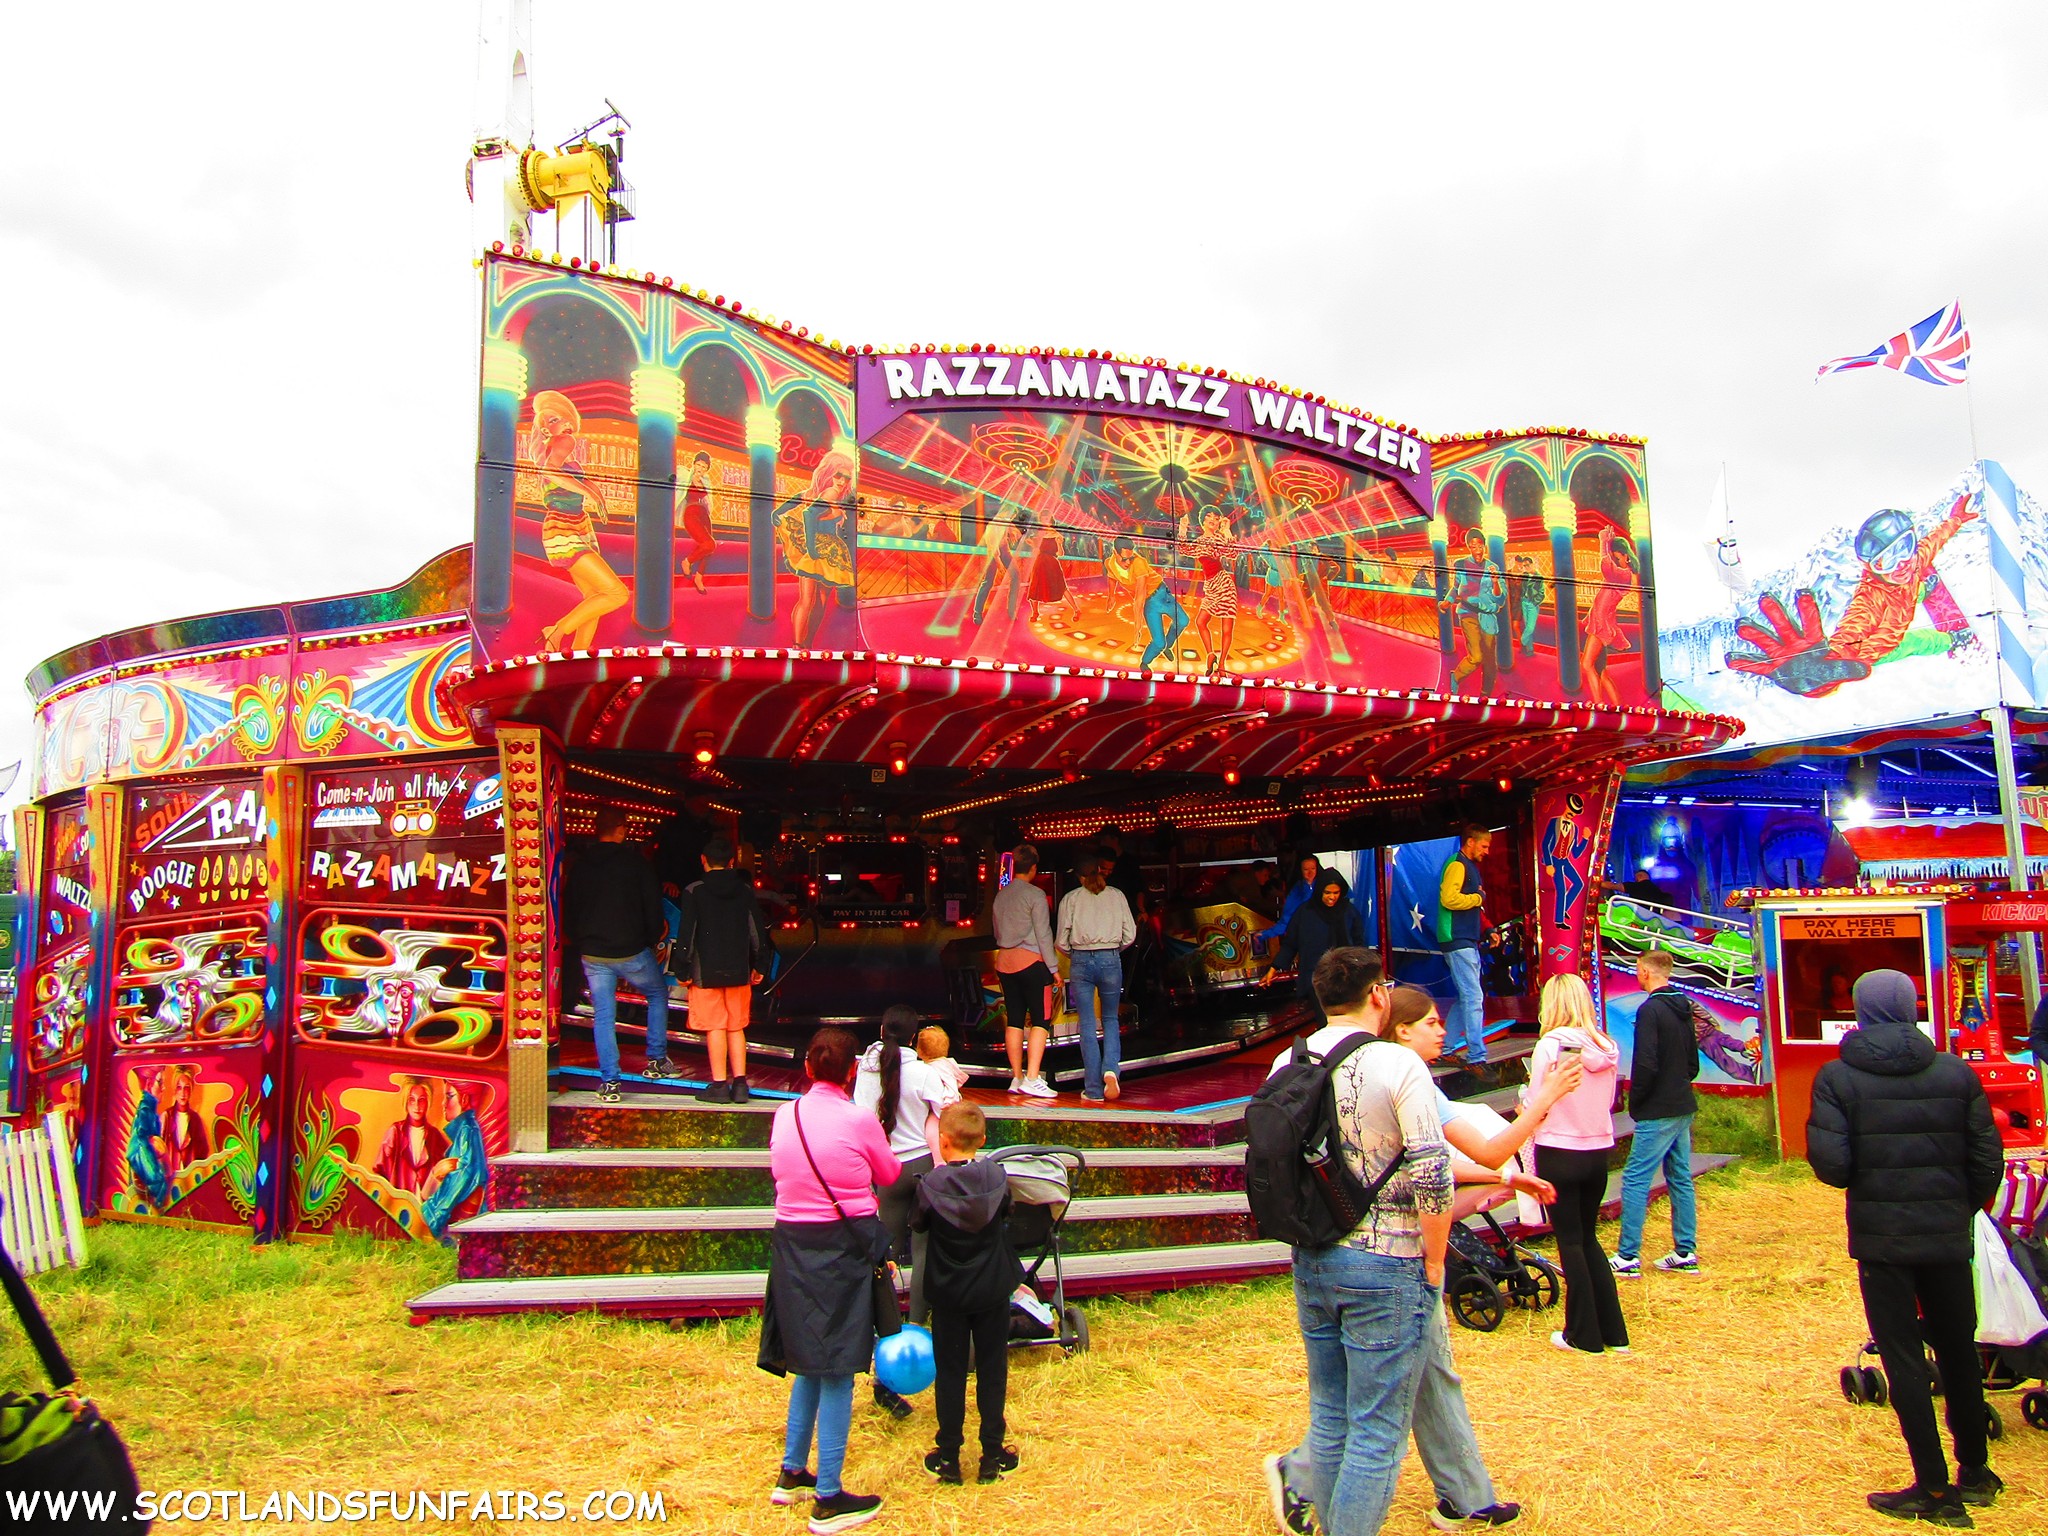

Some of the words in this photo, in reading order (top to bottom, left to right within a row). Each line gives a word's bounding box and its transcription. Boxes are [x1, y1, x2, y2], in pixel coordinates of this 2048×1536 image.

[884, 357, 1231, 419] RAZZAMATAZZ
[1246, 388, 1421, 475] WALTZER
[405, 774, 422, 798] all
[426, 772, 448, 798] the
[136, 790, 196, 849] SOUL
[312, 850, 506, 895] RAZZAMATAZZ
[130, 860, 196, 913] BOOGIE
[833, 909, 851, 917] PAY
[855, 909, 865, 917] IN
[868, 909, 887, 917] THE
[890, 909, 910, 917] CAR
[1803, 919, 1838, 929] PAY
[1847, 918, 1896, 928] HERE
[1982, 903, 2048, 921] KICKP
[1807, 928, 1895, 938] WALTZER
